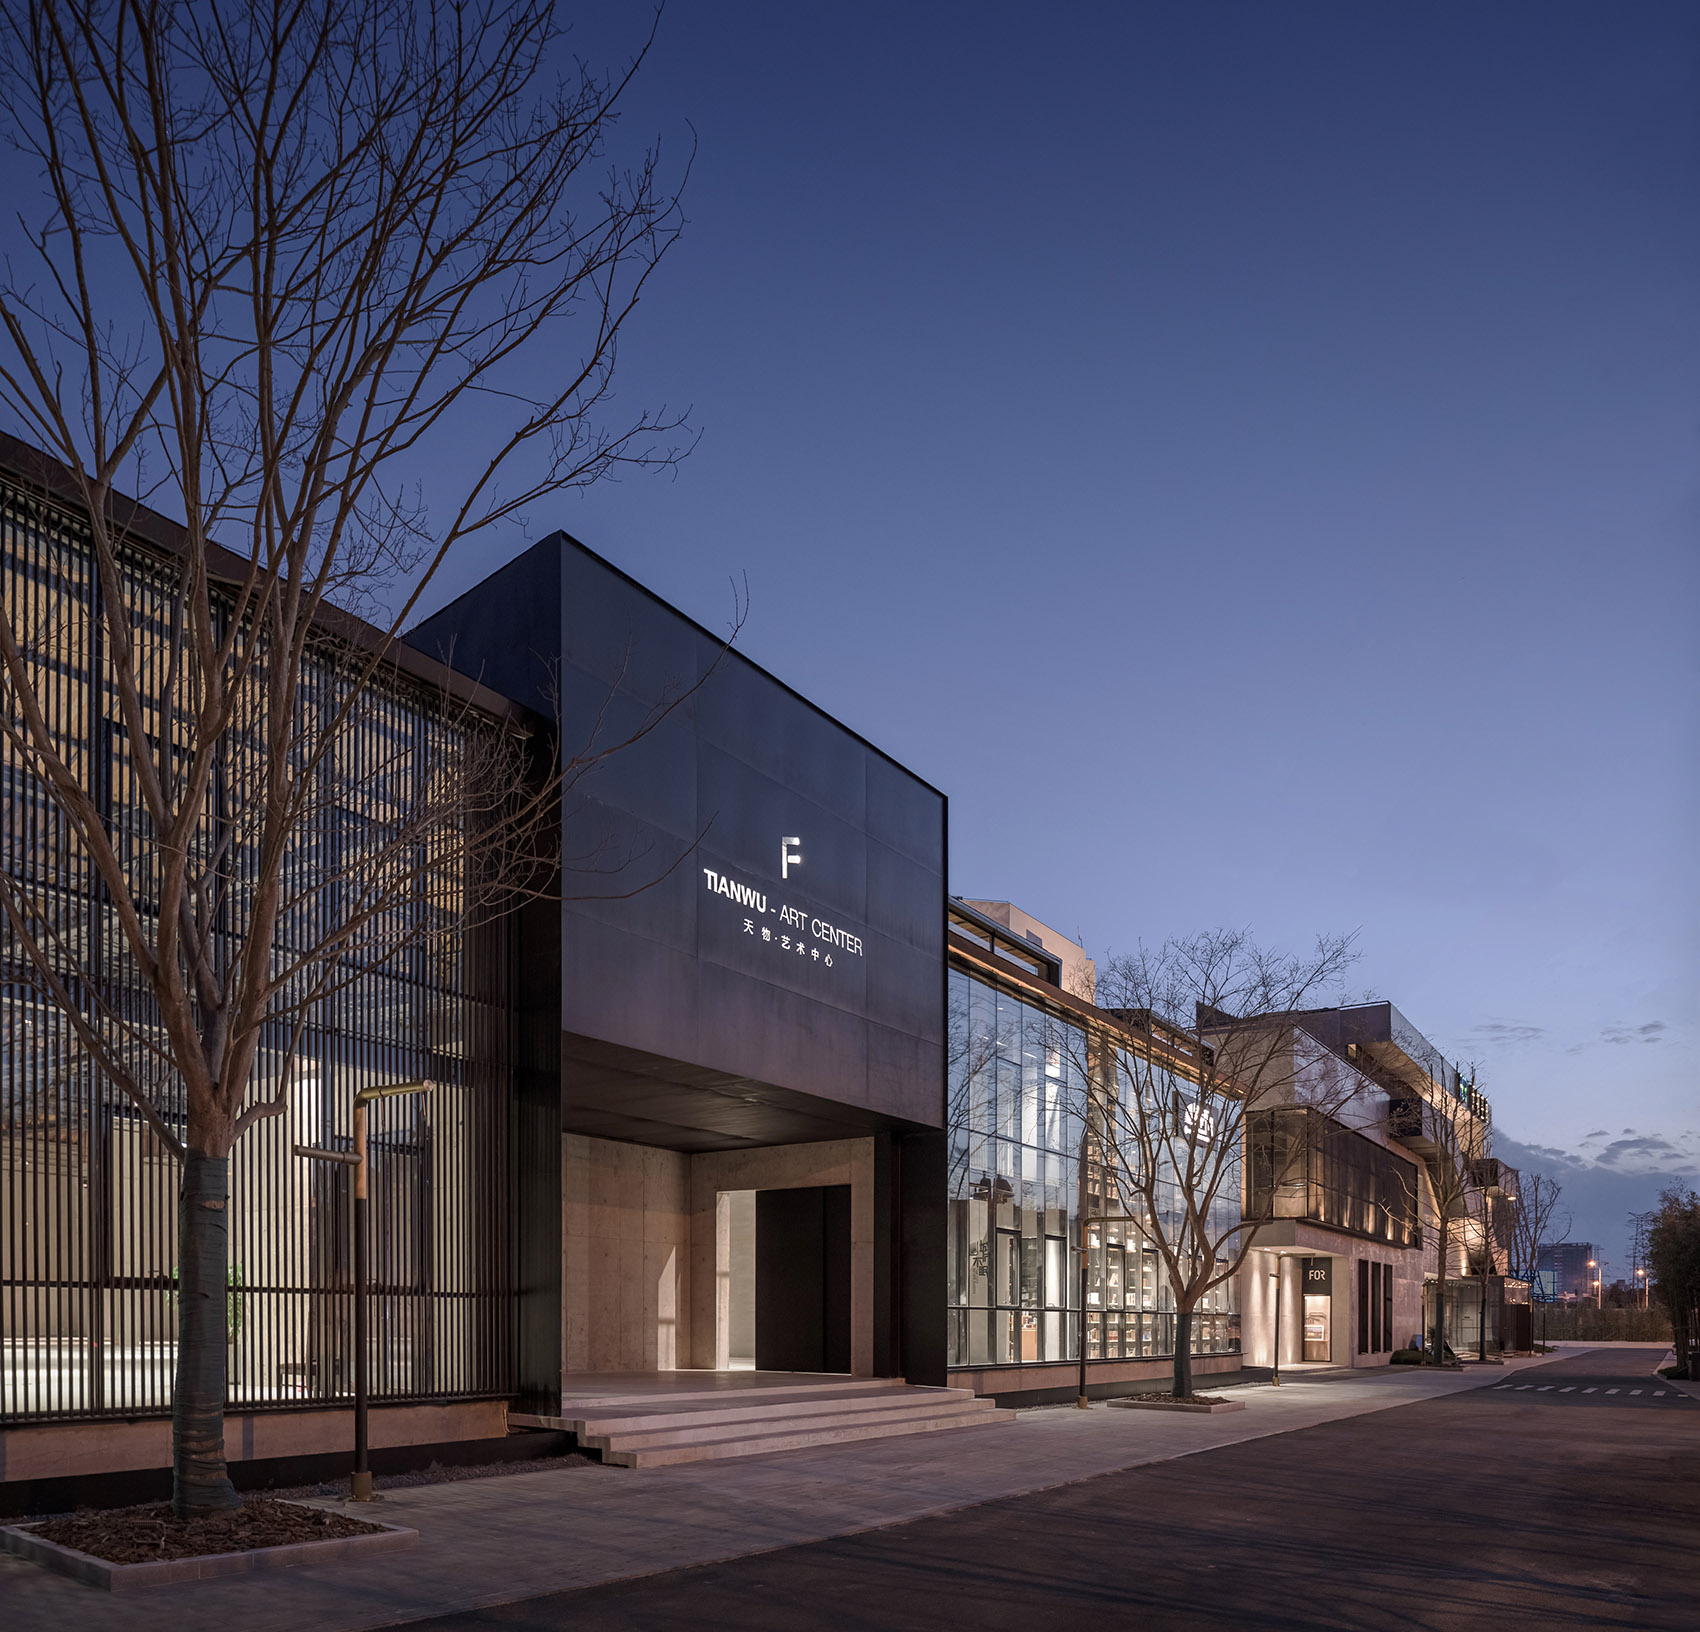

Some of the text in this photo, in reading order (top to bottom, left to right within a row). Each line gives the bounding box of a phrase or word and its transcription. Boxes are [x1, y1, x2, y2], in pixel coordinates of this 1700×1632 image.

[782, 837, 801, 879] F
[704, 868, 767, 913] TIANWU
[780, 905, 808, 931] ART
[811, 919, 863, 957] CENTER
